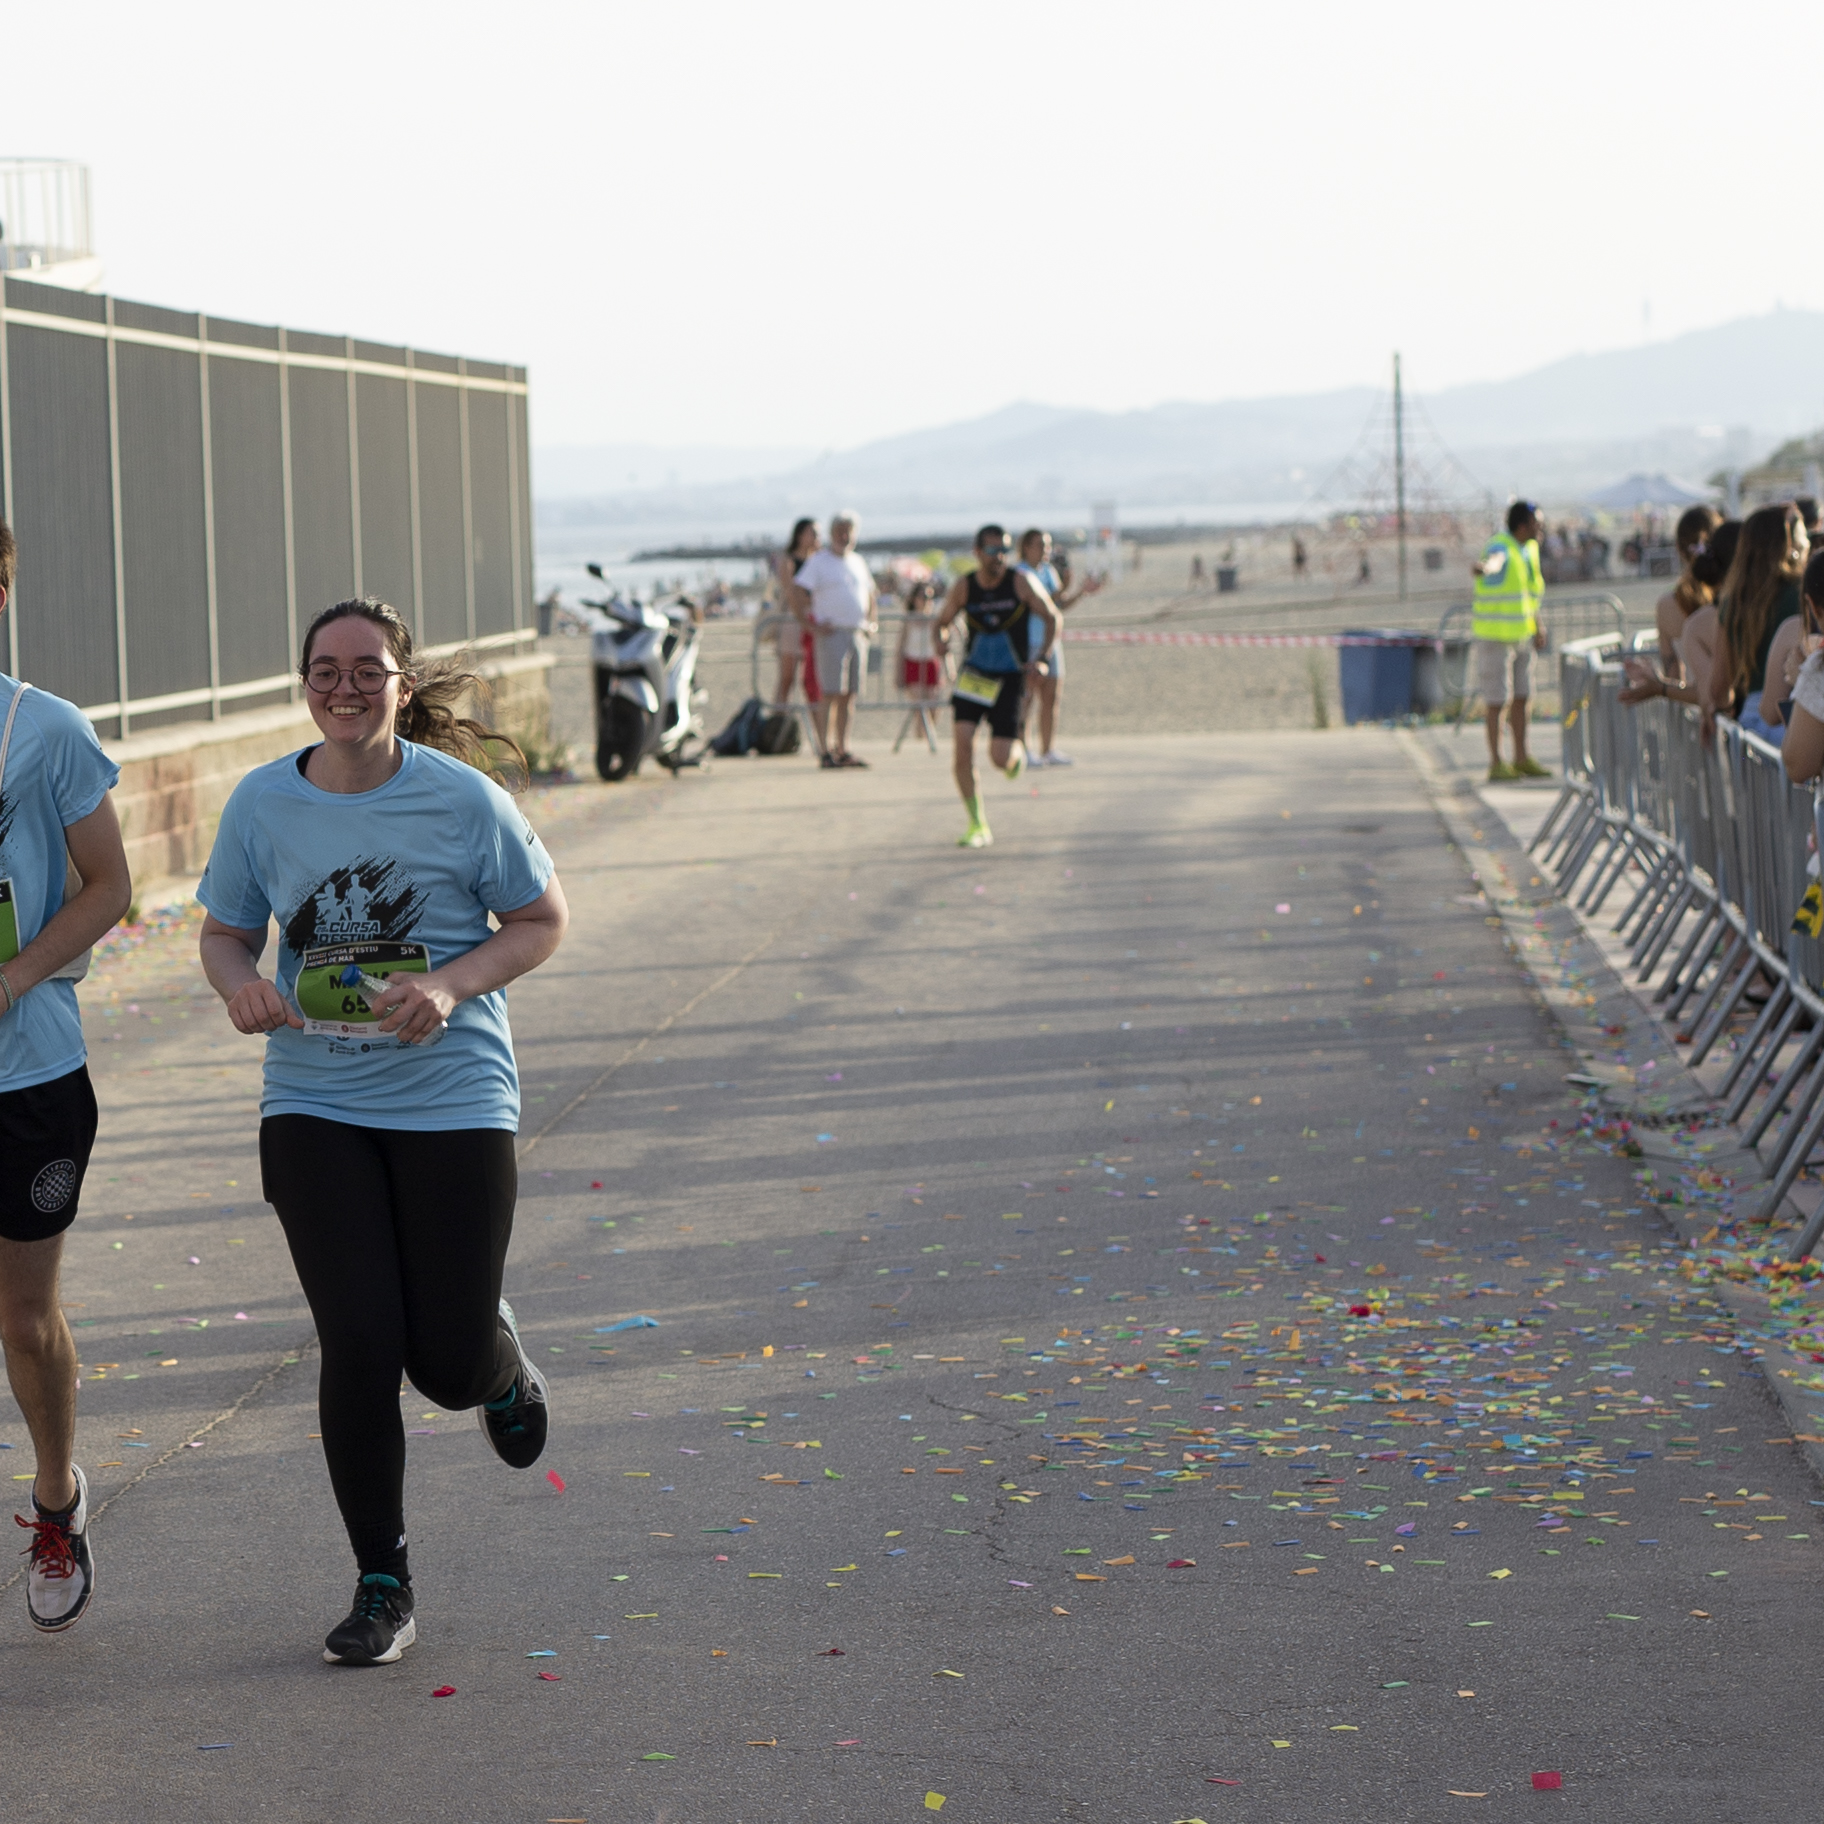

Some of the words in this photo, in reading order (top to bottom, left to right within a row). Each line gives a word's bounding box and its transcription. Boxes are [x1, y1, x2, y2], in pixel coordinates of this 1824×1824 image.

[329, 921, 379, 933] CURSA
[328, 948, 348, 956] CURSA
[348, 945, 379, 954] D'ESTIU
[400, 946, 417, 955] 5K
[329, 956, 337, 964] DE
[341, 994, 372, 1015] 65
